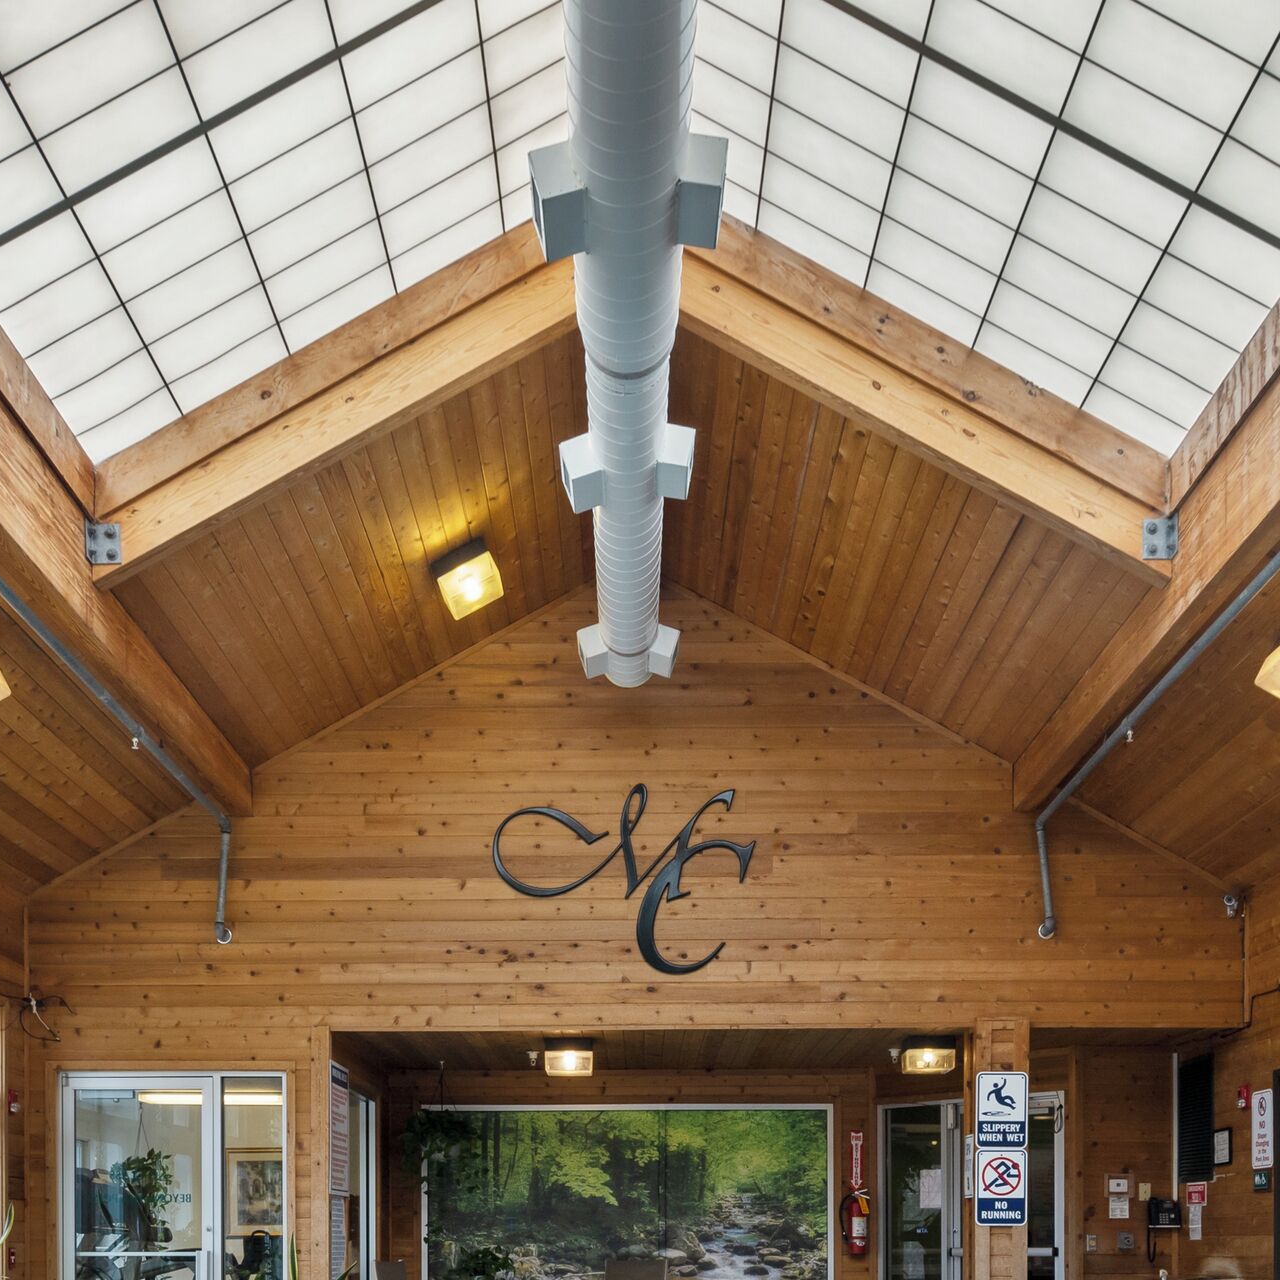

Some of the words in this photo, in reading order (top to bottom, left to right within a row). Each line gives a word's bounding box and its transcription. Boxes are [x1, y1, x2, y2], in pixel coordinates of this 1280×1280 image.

[982, 1123, 1021, 1132] SLIPPERY
[1258, 1120, 1266, 1129] NO
[979, 1133, 1003, 1142] WHEN
[1006, 1133, 1025, 1142] WET
[994, 1200, 1008, 1210] NO
[981, 1210, 1022, 1220] RUNNING
